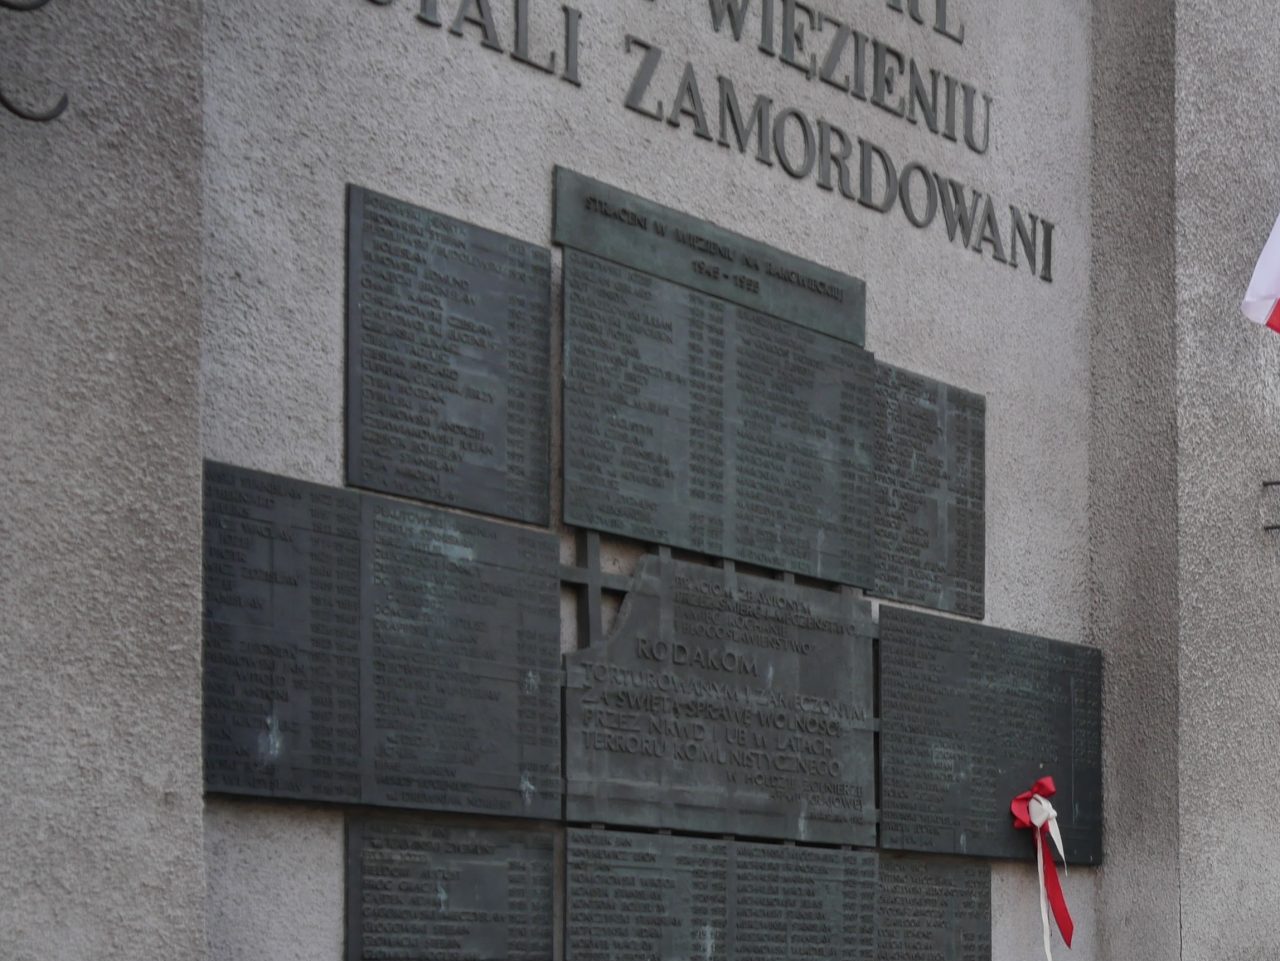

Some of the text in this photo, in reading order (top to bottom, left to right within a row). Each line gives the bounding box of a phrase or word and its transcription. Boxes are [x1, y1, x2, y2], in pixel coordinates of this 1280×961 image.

[624, 34, 1056, 284] ZAMORDOWANI
[583, 658, 738, 704] TORTUROWANYM
[637, 634, 757, 679] RODAKOM
[582, 705, 640, 733] PRZEZ
[648, 715, 705, 741] NKWD
[775, 732, 831, 757] LATACH
[582, 726, 841, 780] TERRORU KOMUNISTYCZNEGO
